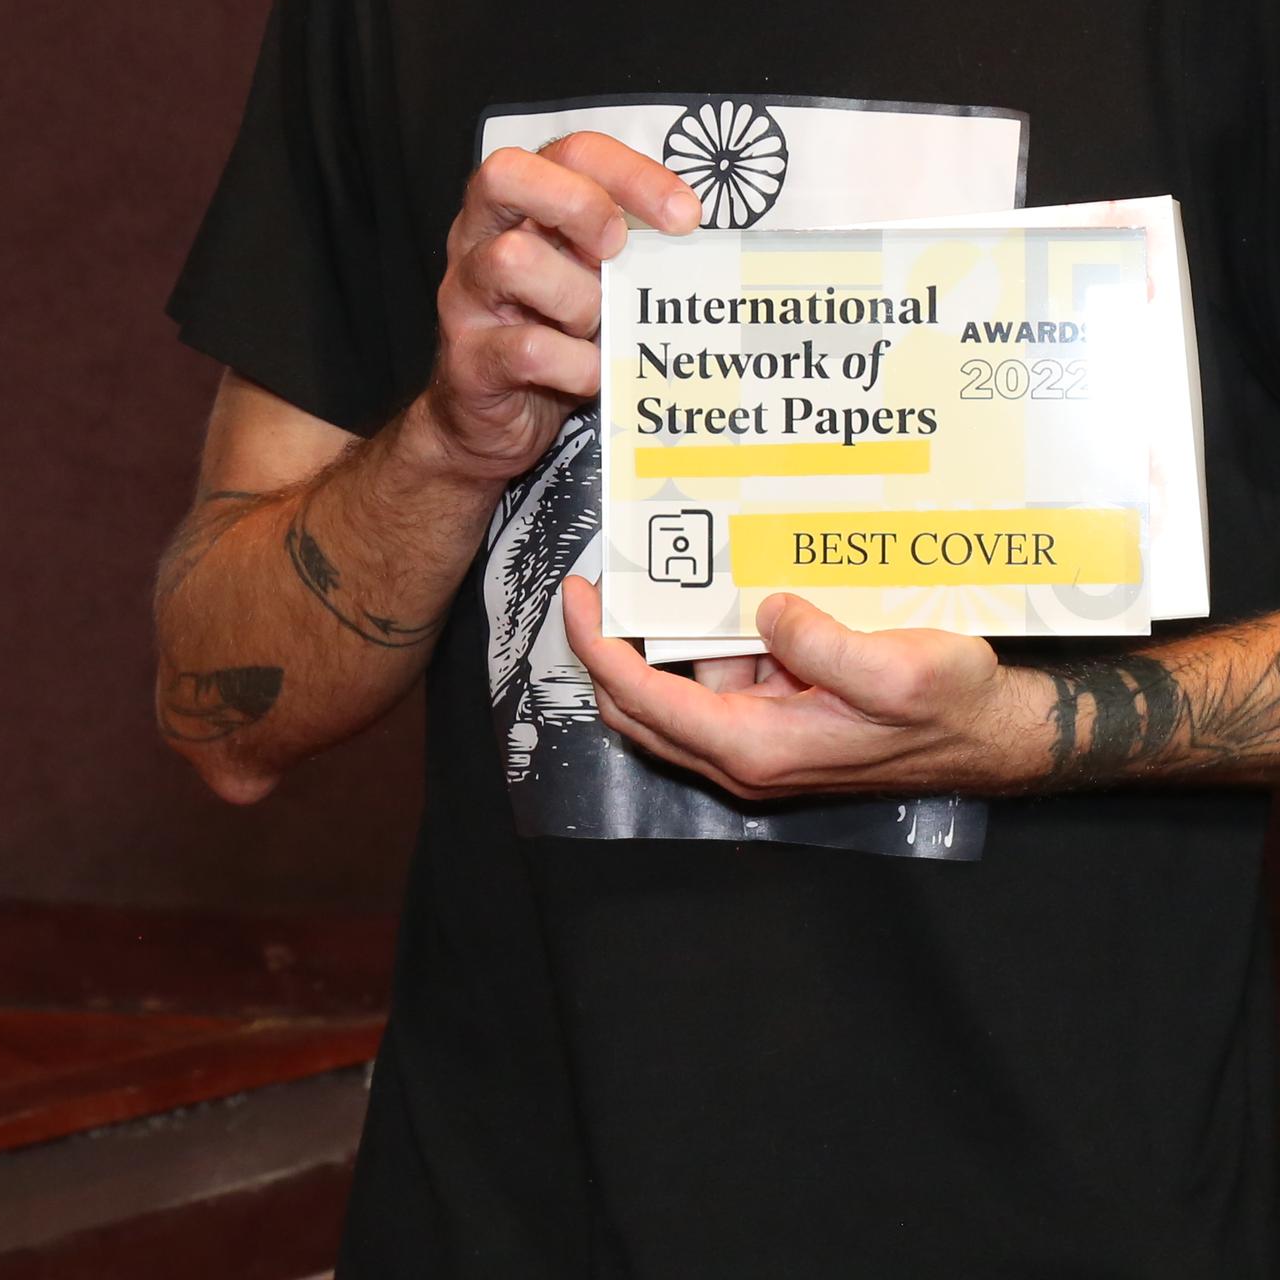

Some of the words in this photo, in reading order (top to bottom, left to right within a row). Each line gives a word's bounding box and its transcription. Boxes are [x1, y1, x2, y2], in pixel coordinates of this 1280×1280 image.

[636, 286, 938, 326] International
[636, 340, 830, 380] Network
[842, 339, 893, 392] of
[636, 396, 768, 435] Street
[781, 397, 938, 447] Papers
[793, 532, 897, 566] BEST
[910, 532, 1057, 567] COVER
